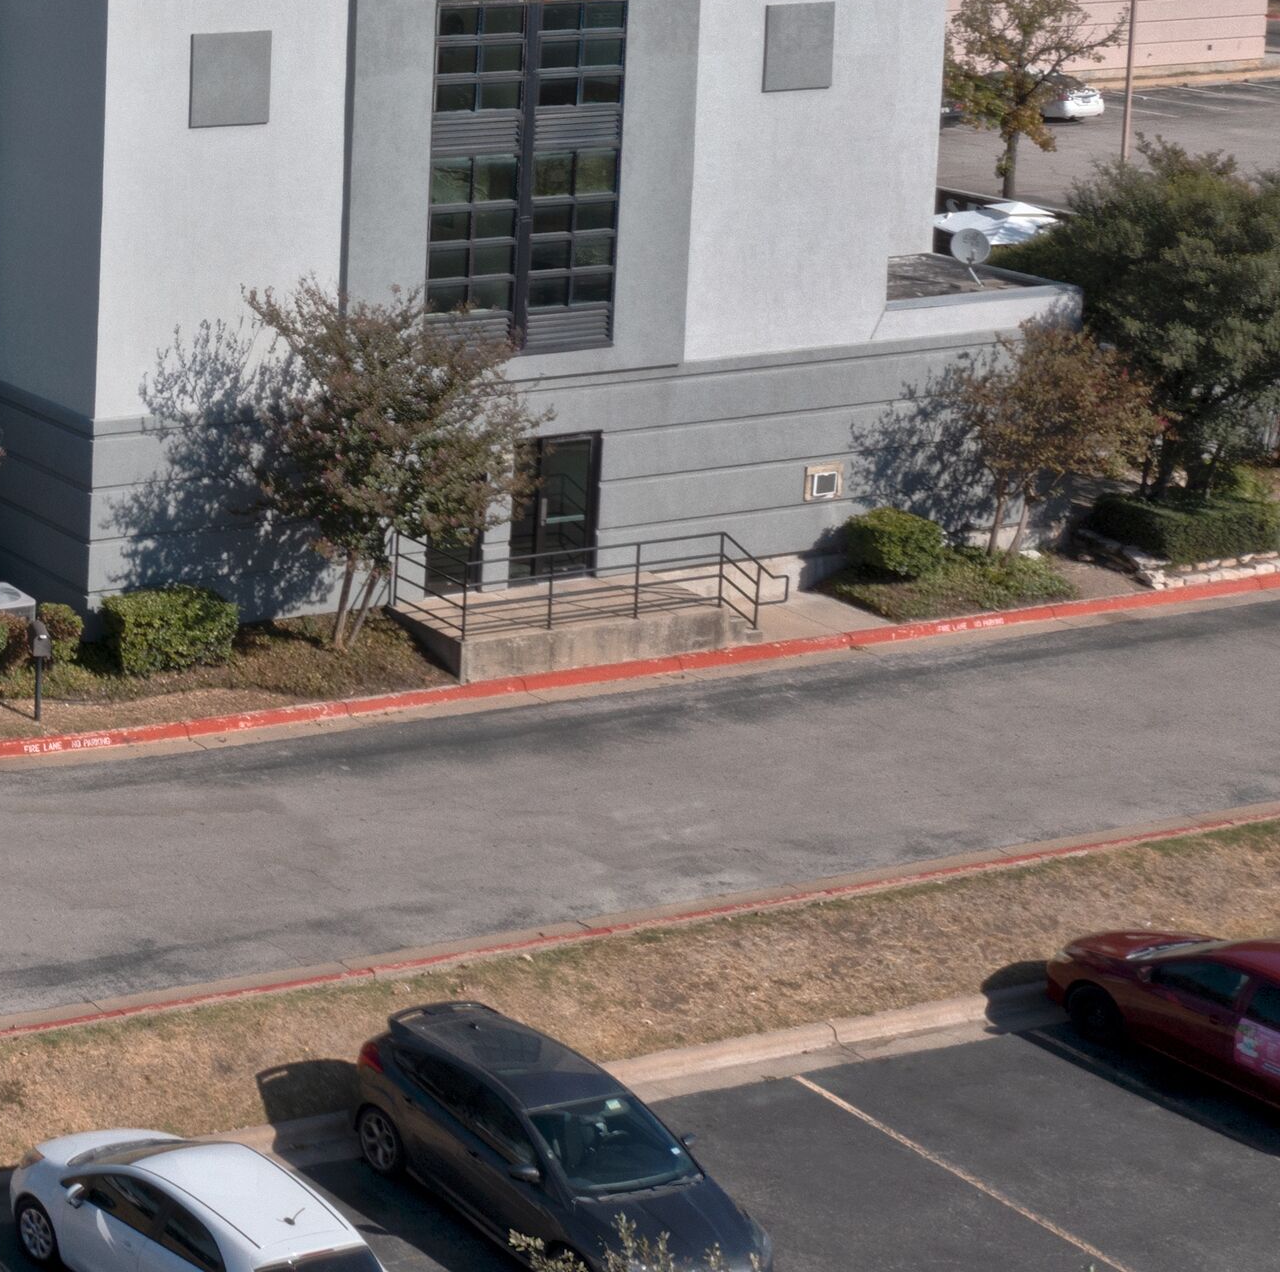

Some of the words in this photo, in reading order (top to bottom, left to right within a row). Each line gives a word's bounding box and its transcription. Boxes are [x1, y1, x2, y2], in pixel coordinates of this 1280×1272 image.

[23, 743, 41, 753] FIRE
[43, 741, 63, 752] LANE
[83, 737, 111, 747] PARKING
